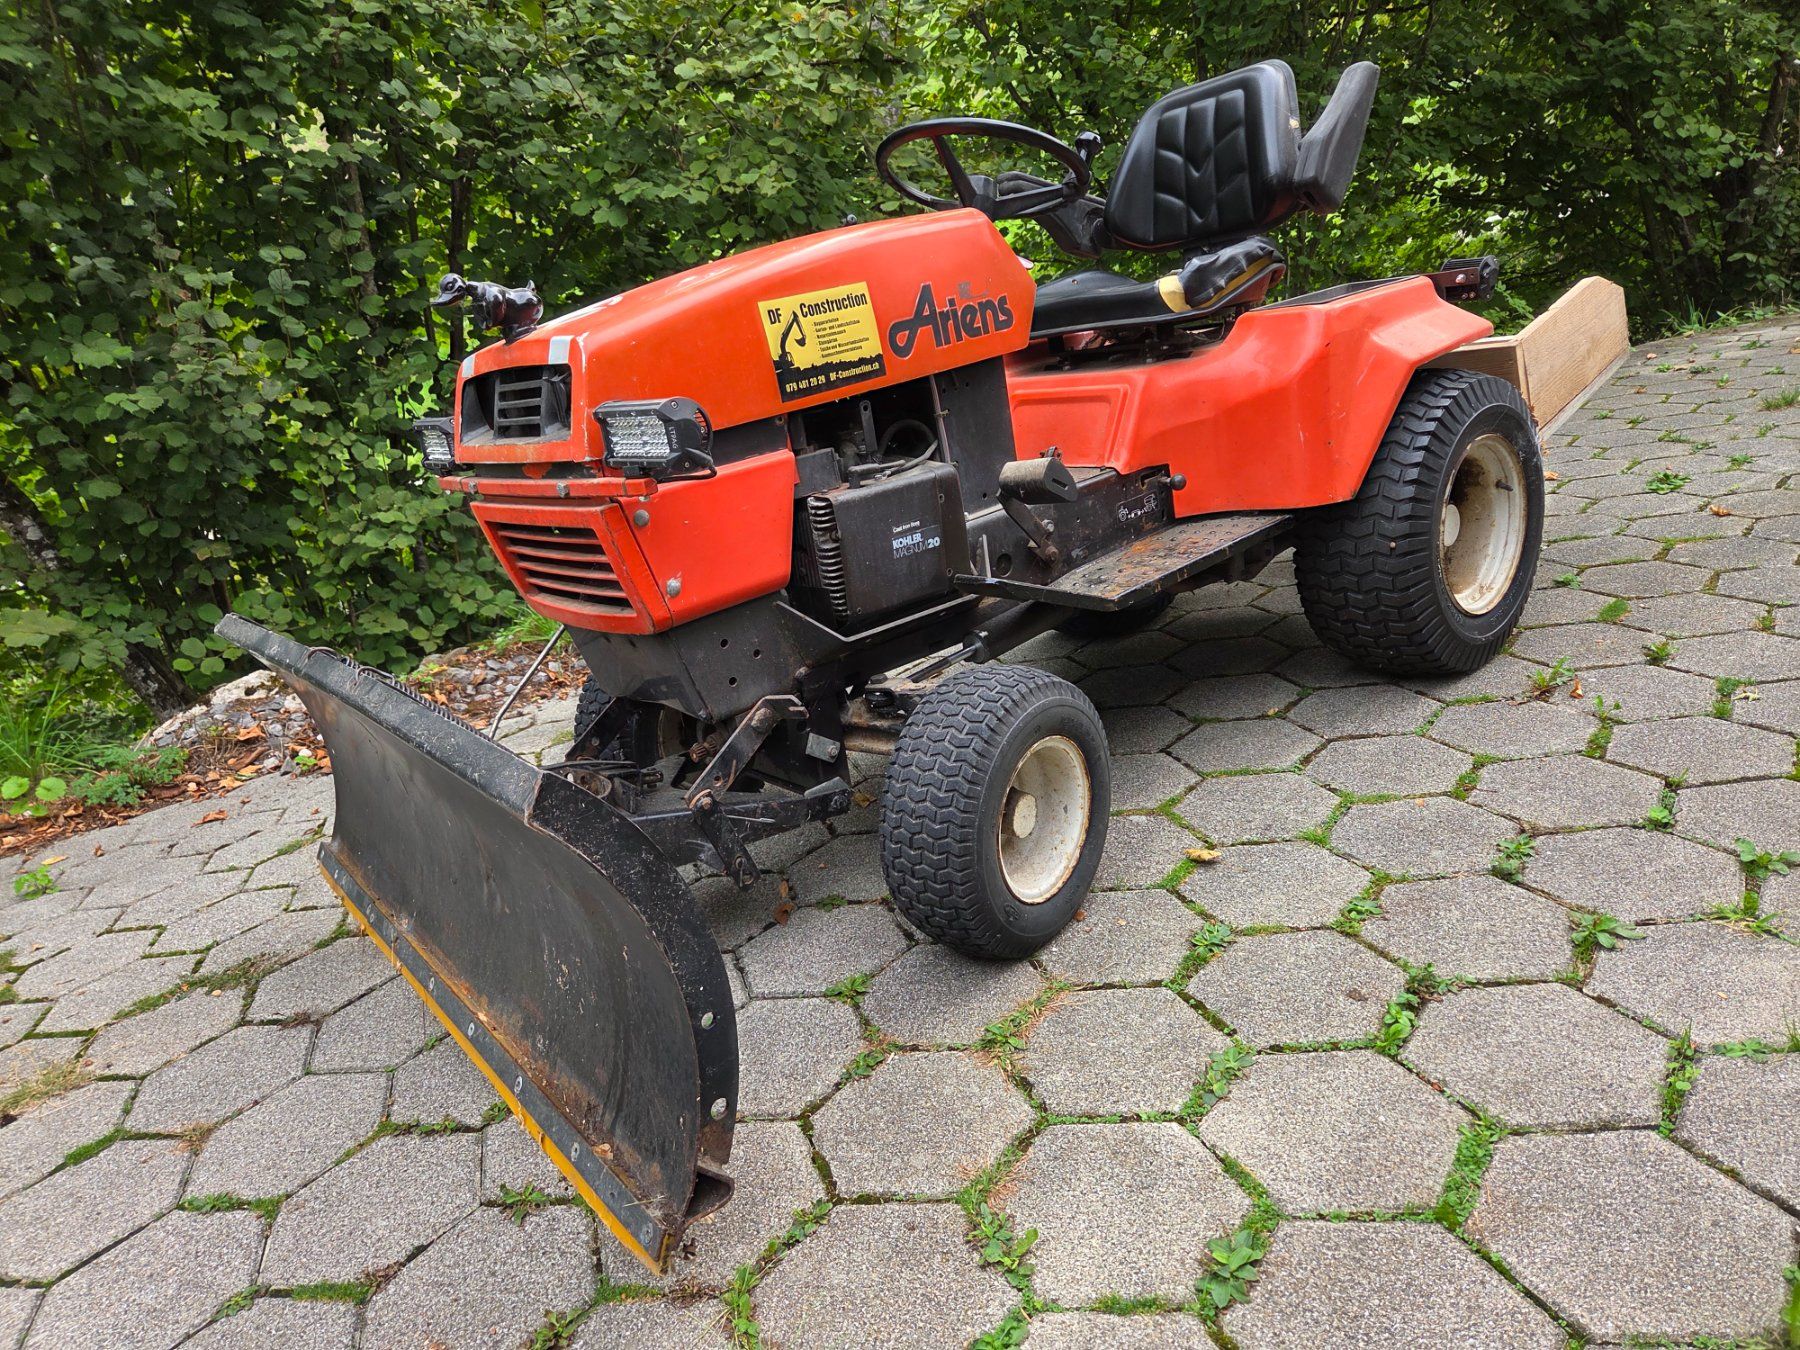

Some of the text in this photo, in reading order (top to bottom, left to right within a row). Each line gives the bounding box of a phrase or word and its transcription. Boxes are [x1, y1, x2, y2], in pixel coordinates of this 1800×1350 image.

[767, 293, 868, 325] DF Construction
[887, 282, 1015, 360] Ariens
[785, 382, 798, 393] 079
[892, 532, 922, 550] KOHLER
[893, 536, 940, 559] MAGNUM 20
